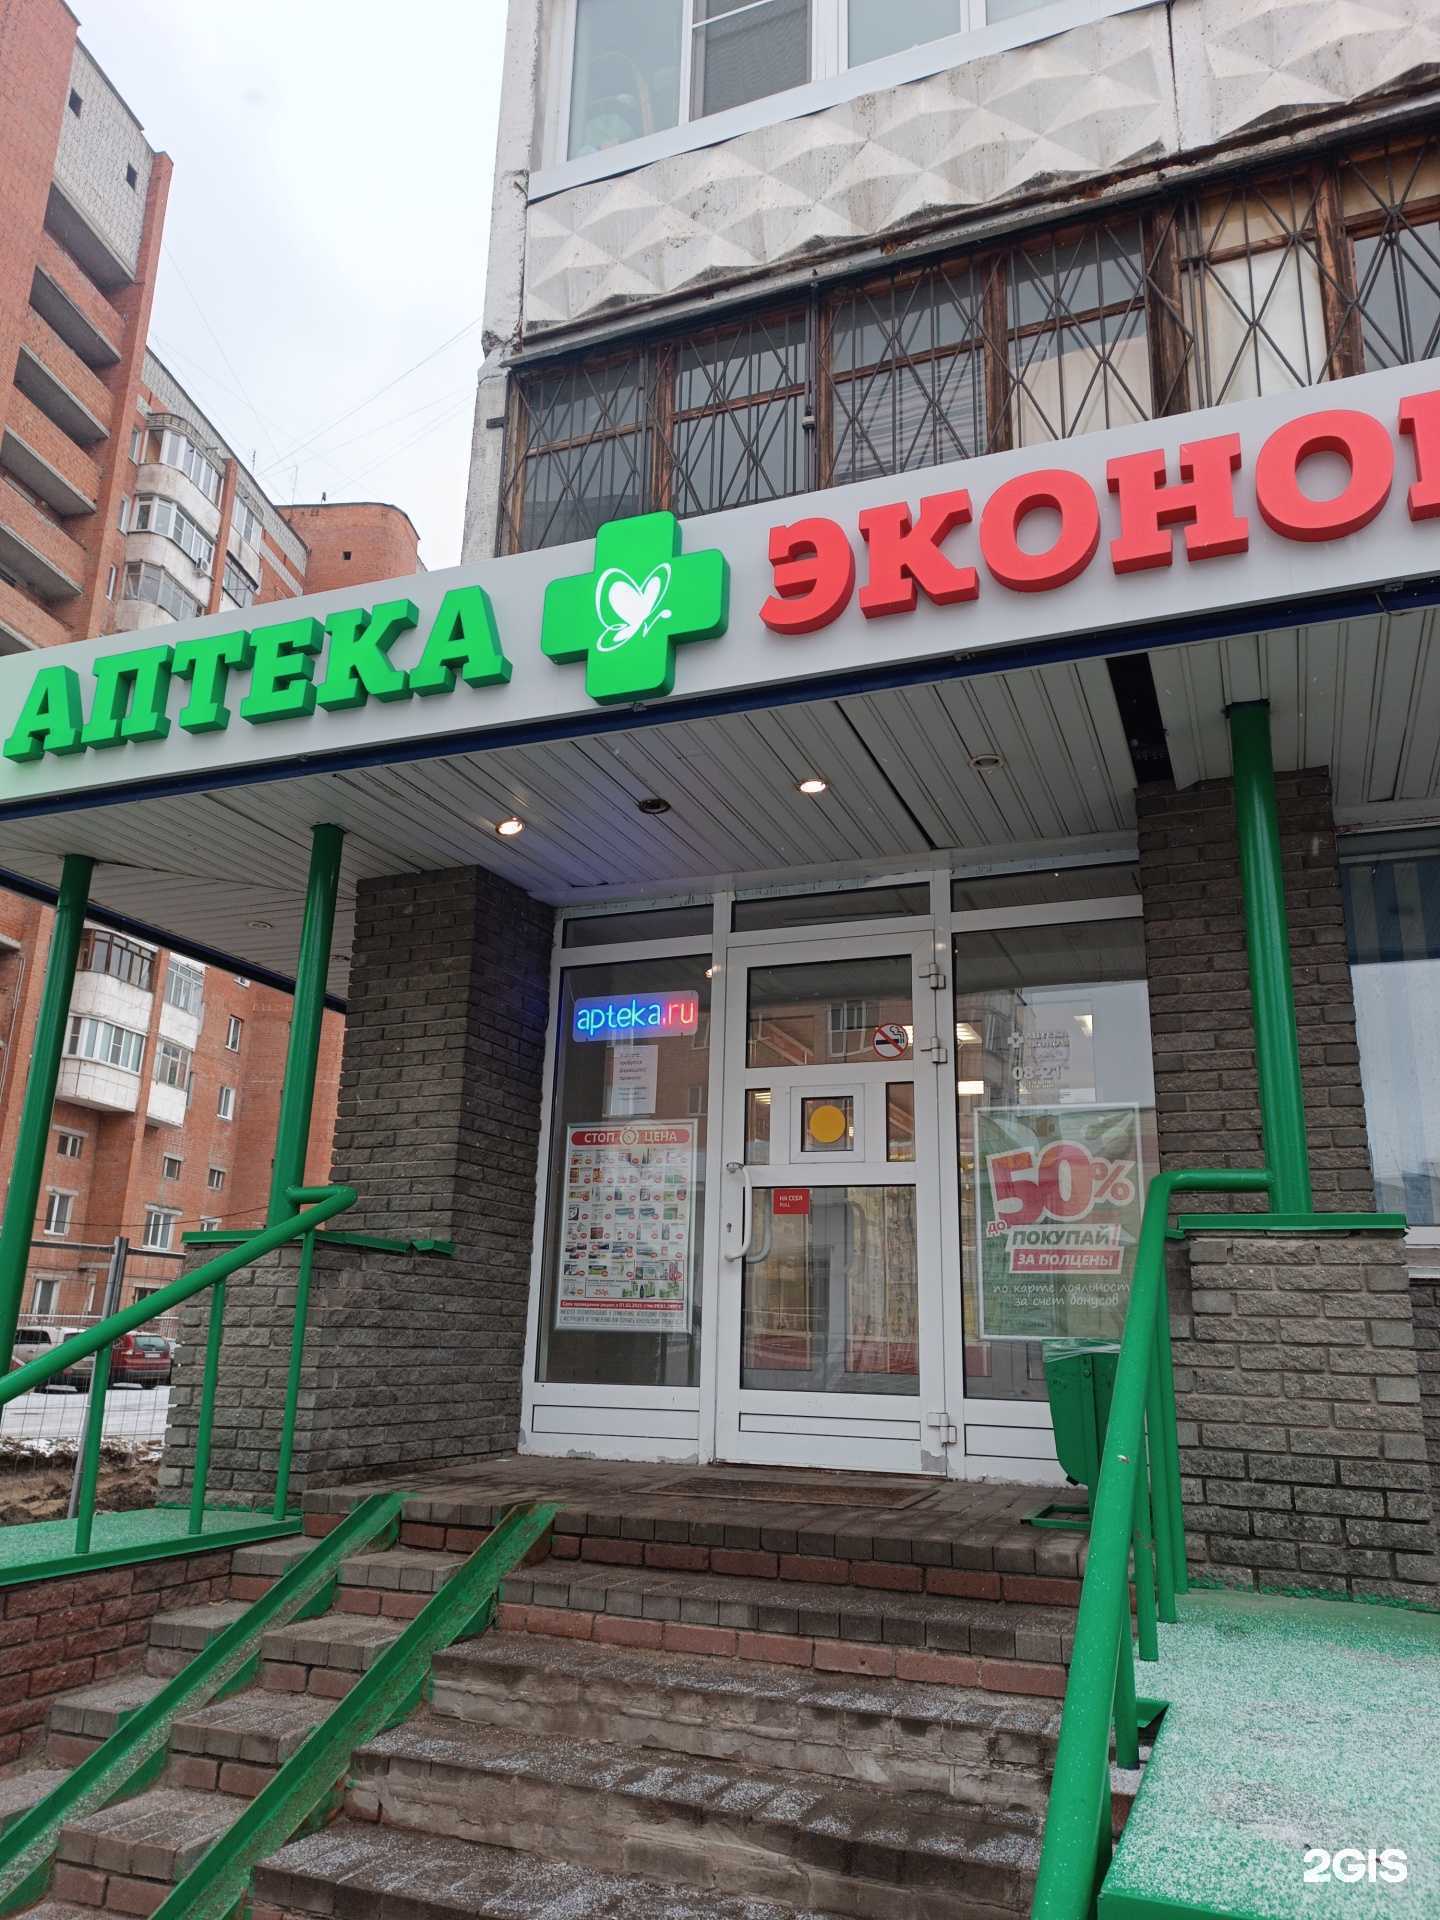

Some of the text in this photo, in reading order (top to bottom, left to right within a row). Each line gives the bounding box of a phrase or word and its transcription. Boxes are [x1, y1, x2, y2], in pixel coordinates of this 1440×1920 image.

[3, 585, 512, 763] АПТЕКА
[577, 999, 694, 1036] apteka.ru
[584, 1130, 678, 1143] СТОП ЦЕНА
[988, 1143, 1133, 1224] 50%
[1017, 1254, 1113, 1268] ЗА ПОЛЦЕНЫ
[1059, 1282, 1130, 1294] лояльност
